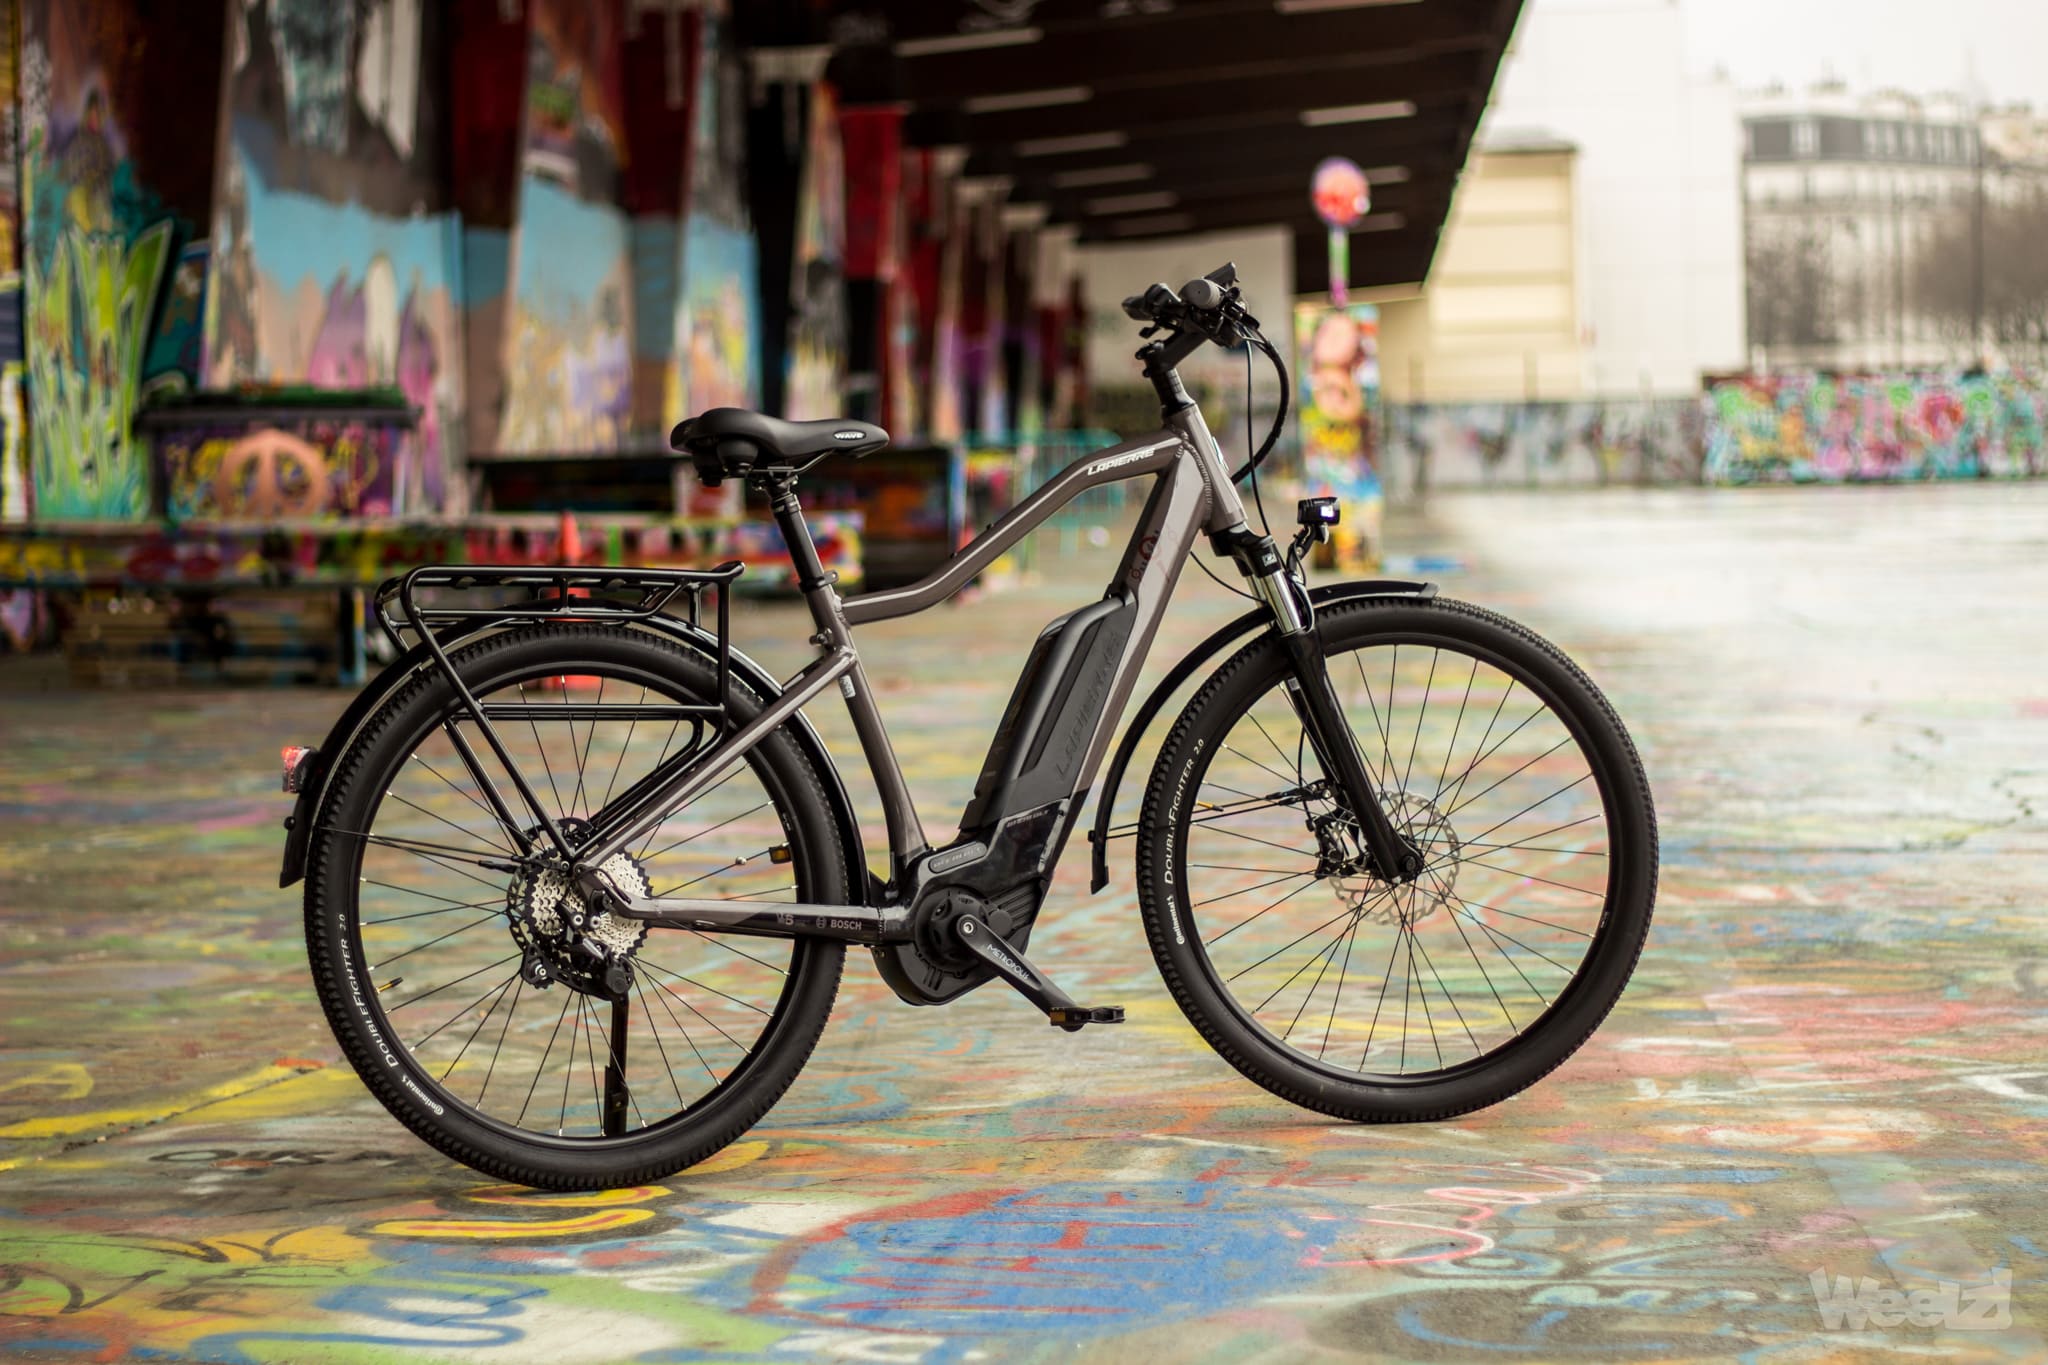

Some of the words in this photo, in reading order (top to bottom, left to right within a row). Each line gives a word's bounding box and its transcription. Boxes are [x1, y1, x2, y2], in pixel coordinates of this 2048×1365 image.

[1087, 447, 1156, 476] LAPIERRE
[1193, 738, 1205, 755] 2.0
[830, 919, 862, 931] BOSCH
[986, 943, 1030, 980] METROPOLIS
